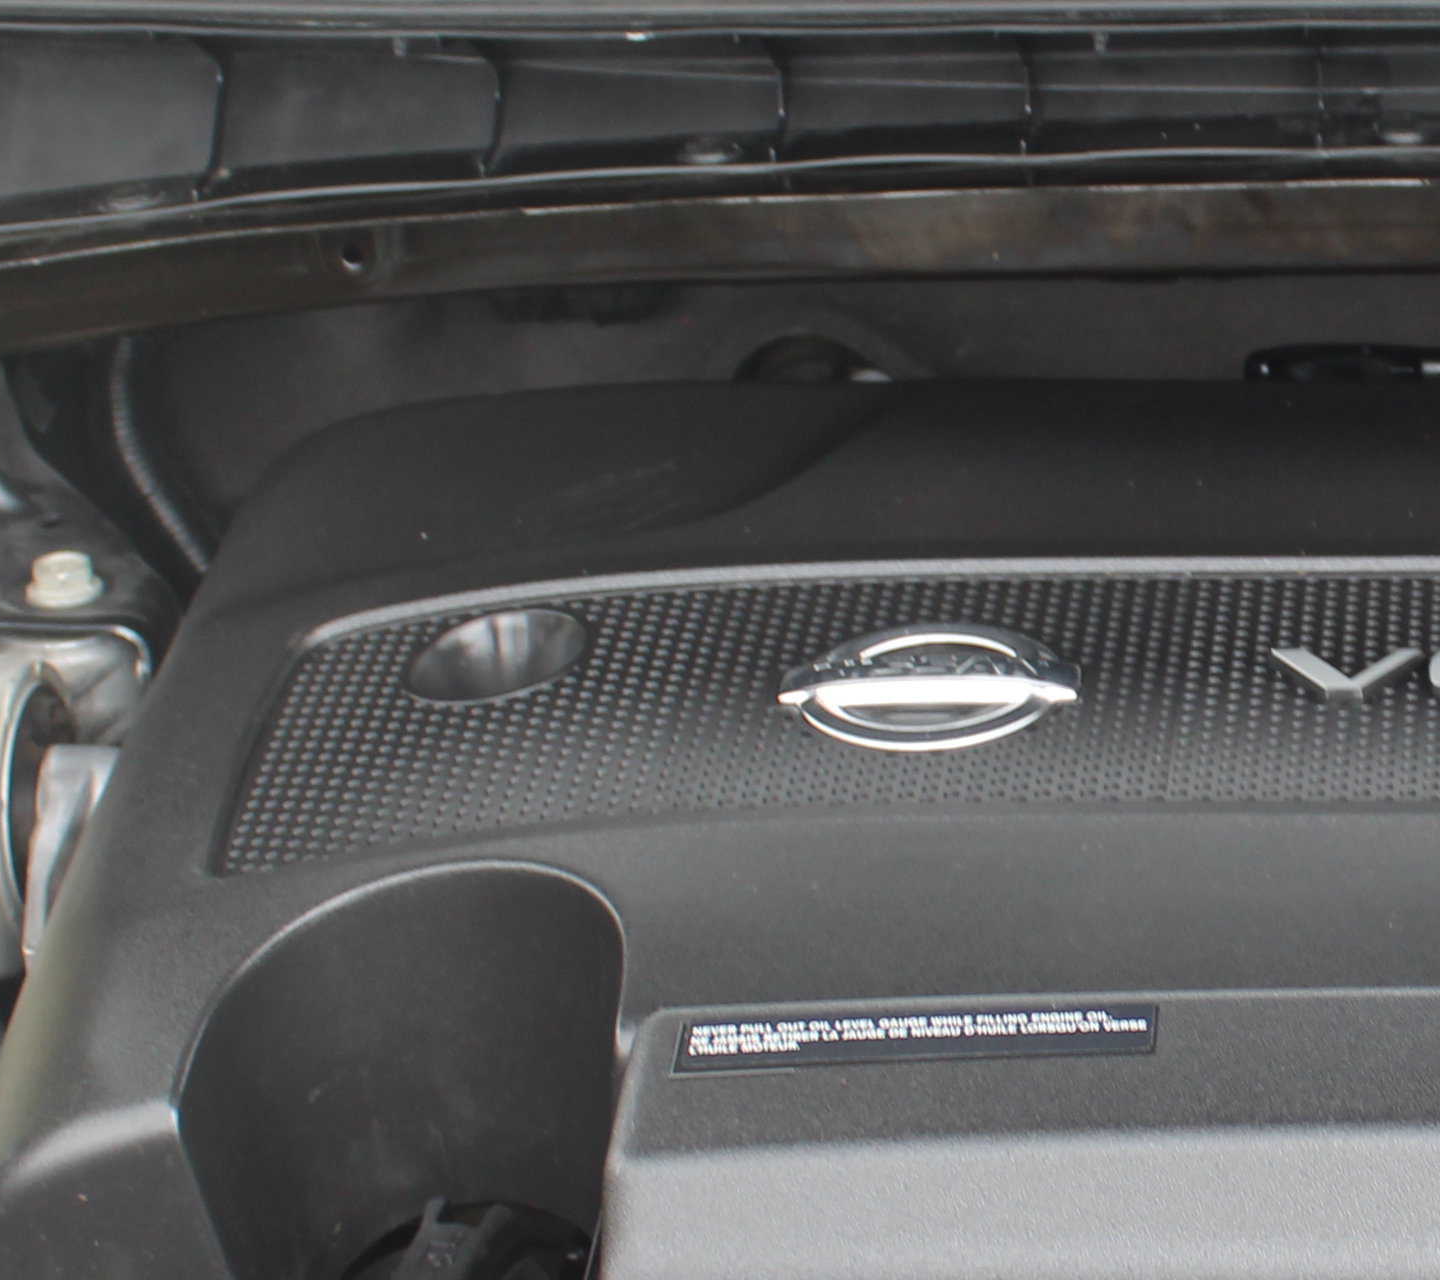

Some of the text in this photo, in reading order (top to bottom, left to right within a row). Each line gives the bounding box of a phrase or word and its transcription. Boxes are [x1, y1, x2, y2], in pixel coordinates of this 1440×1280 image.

[691, 1024, 738, 1036] NEVER
[739, 1022, 773, 1034] PULL
[776, 1021, 806, 1032] OUT
[809, 1020, 832, 1031] OIL
[834, 1019, 875, 1031] LEVEL
[878, 1017, 928, 1029] GAUGE
[930, 1015, 973, 1027] WHILE
[976, 1013, 1028, 1025] FILLING
[1031, 1011, 1084, 1023] ENGINE
[821, 1030, 840, 1041] LA
[841, 1028, 886, 1041] JAUGE
[888, 1027, 908, 1039] DE
[911, 1026, 962, 1038] NIVEAU
